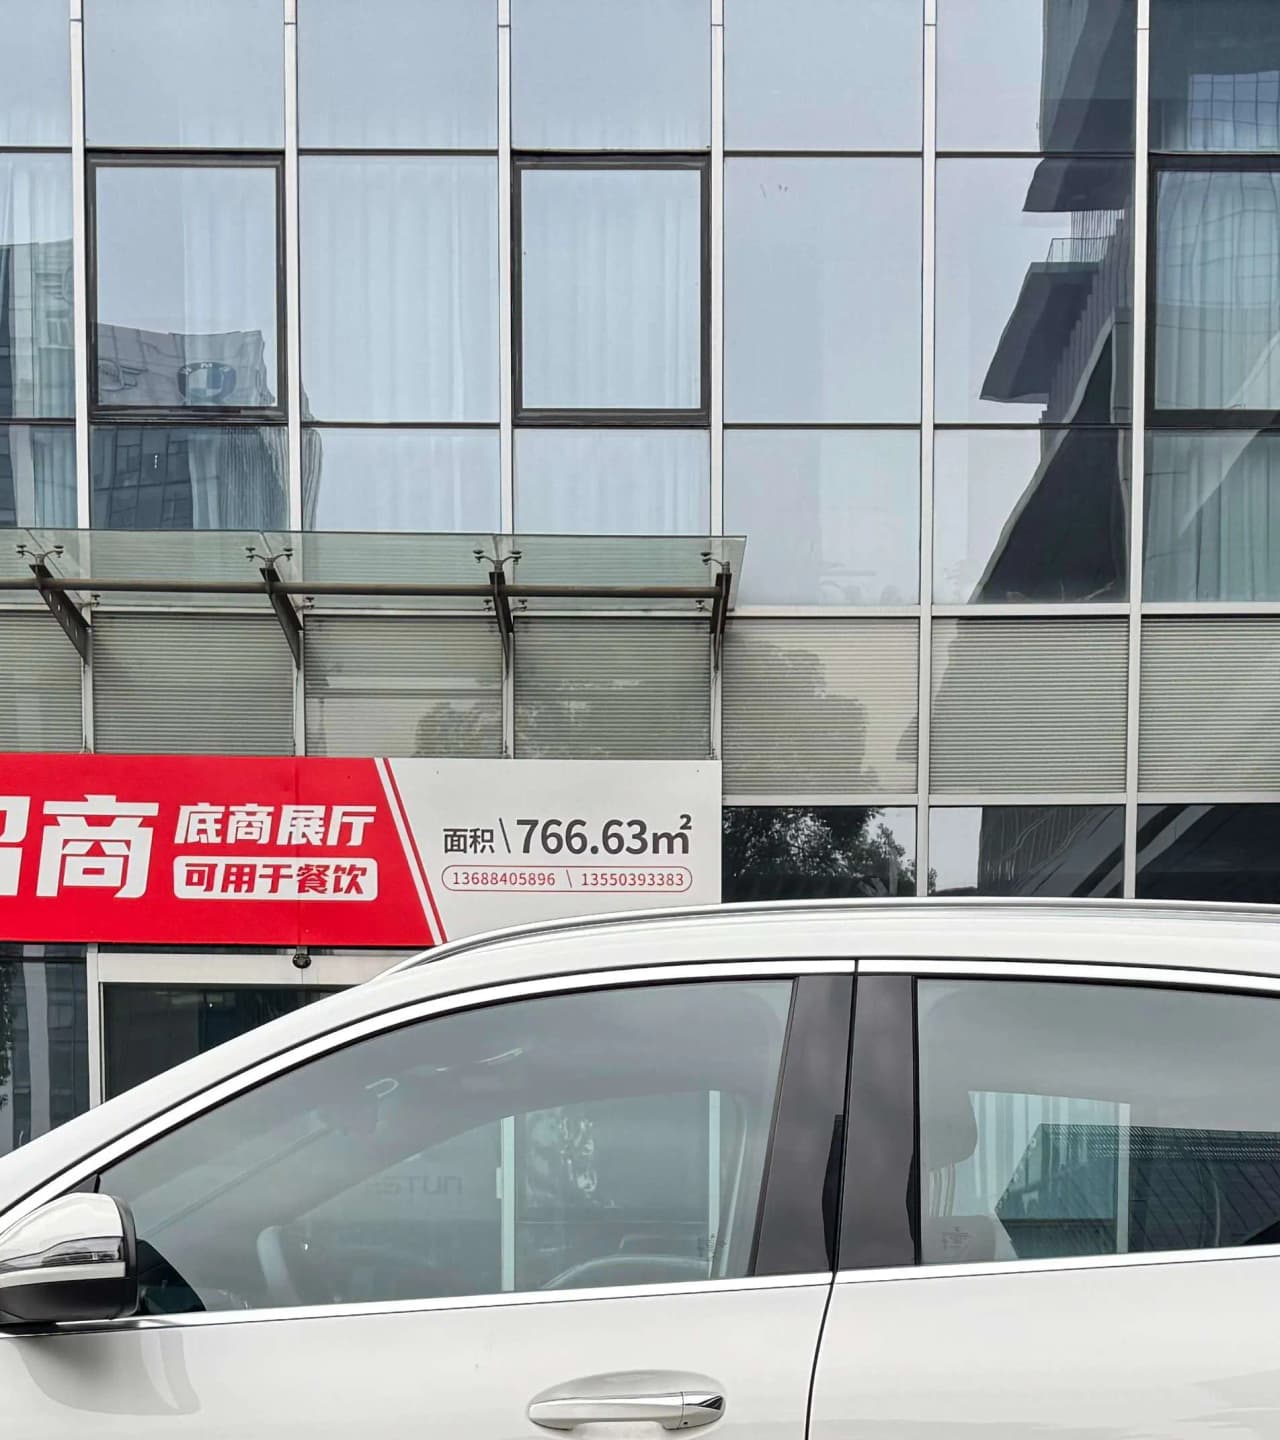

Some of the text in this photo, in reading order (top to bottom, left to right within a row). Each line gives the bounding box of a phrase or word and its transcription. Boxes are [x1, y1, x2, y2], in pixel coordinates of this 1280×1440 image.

[174, 803, 376, 847] 底商展厅
[442, 827, 495, 854] 面积
[184, 862, 368, 895] 可用于餐饮
[452, 871, 684, 887] 13688405896 13550393383
